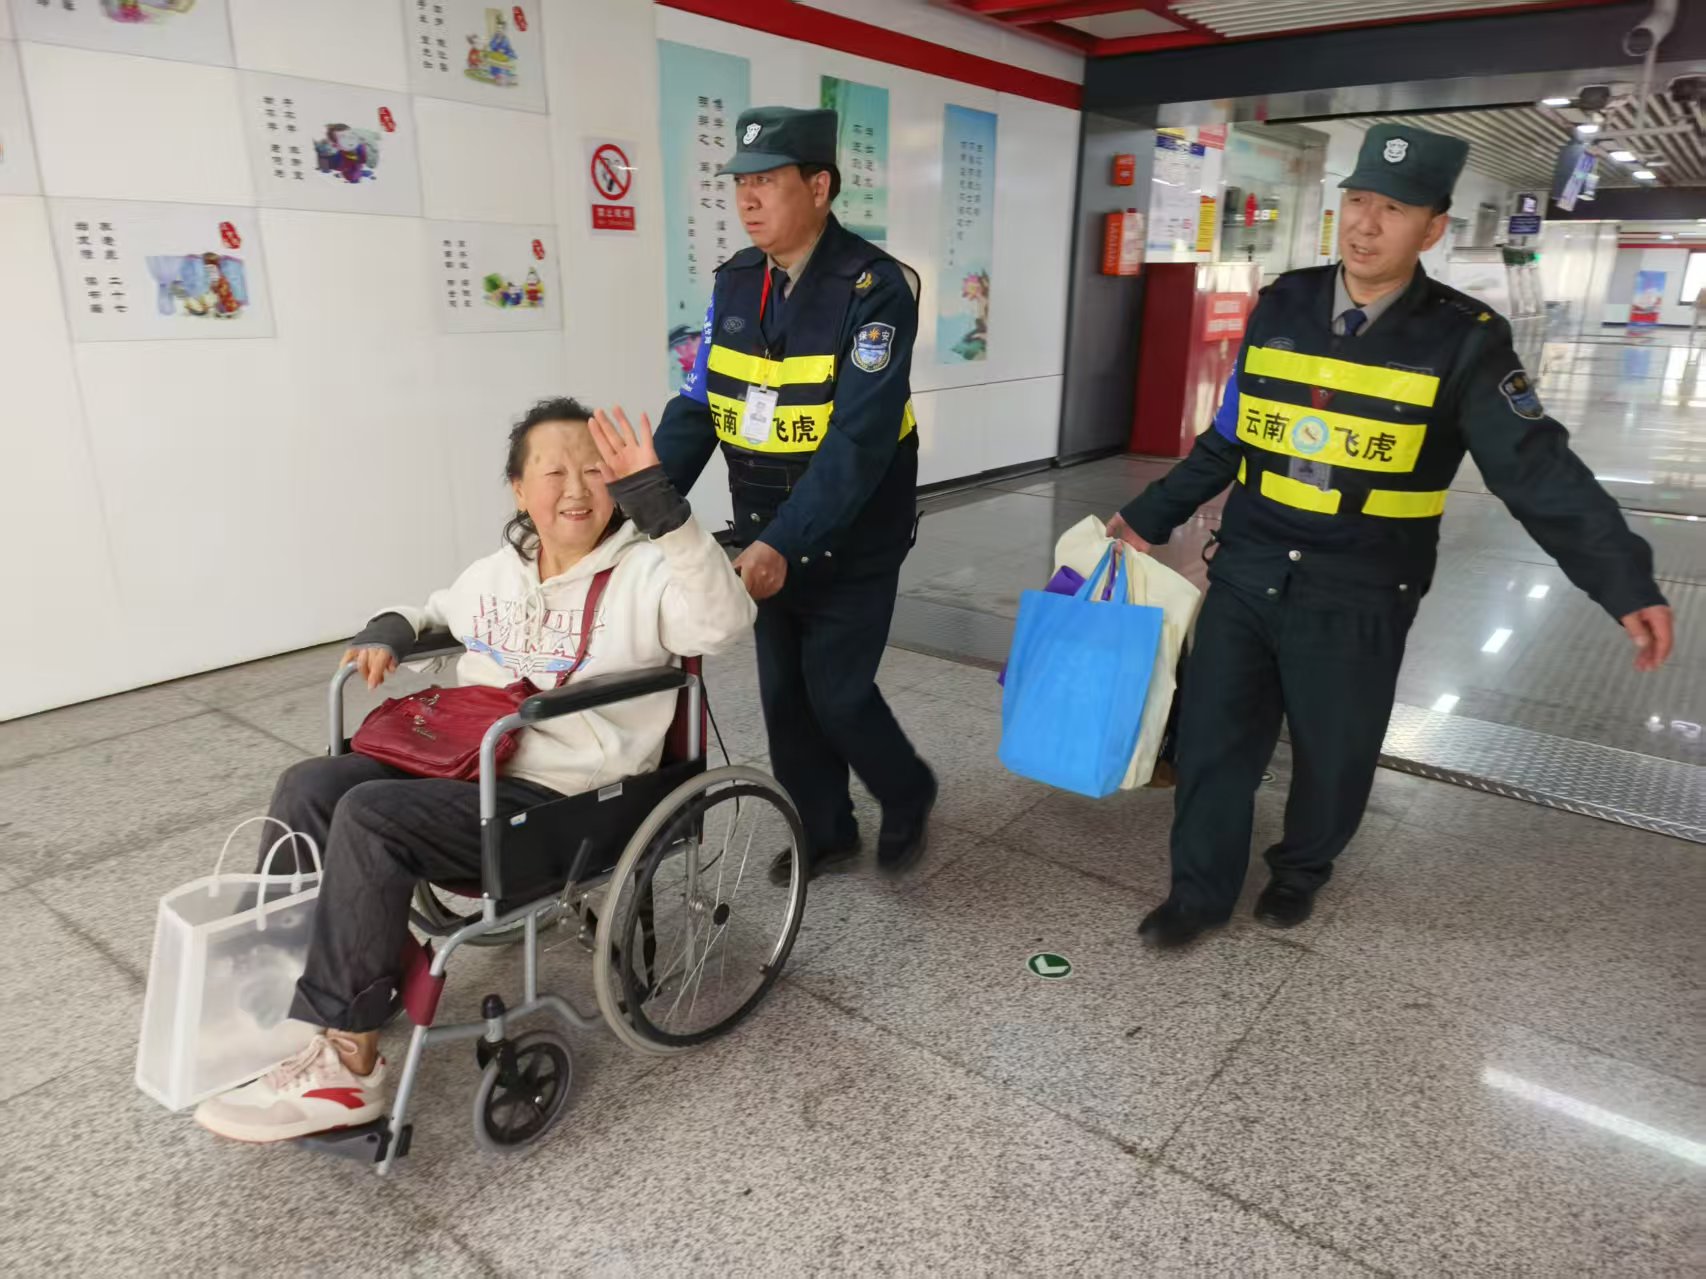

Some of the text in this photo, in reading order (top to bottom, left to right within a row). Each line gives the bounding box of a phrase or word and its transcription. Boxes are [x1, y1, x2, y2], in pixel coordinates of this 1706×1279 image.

[711, 405, 819, 444] 云南 飞虎
[1245, 408, 1398, 463] 云南 飞虎
